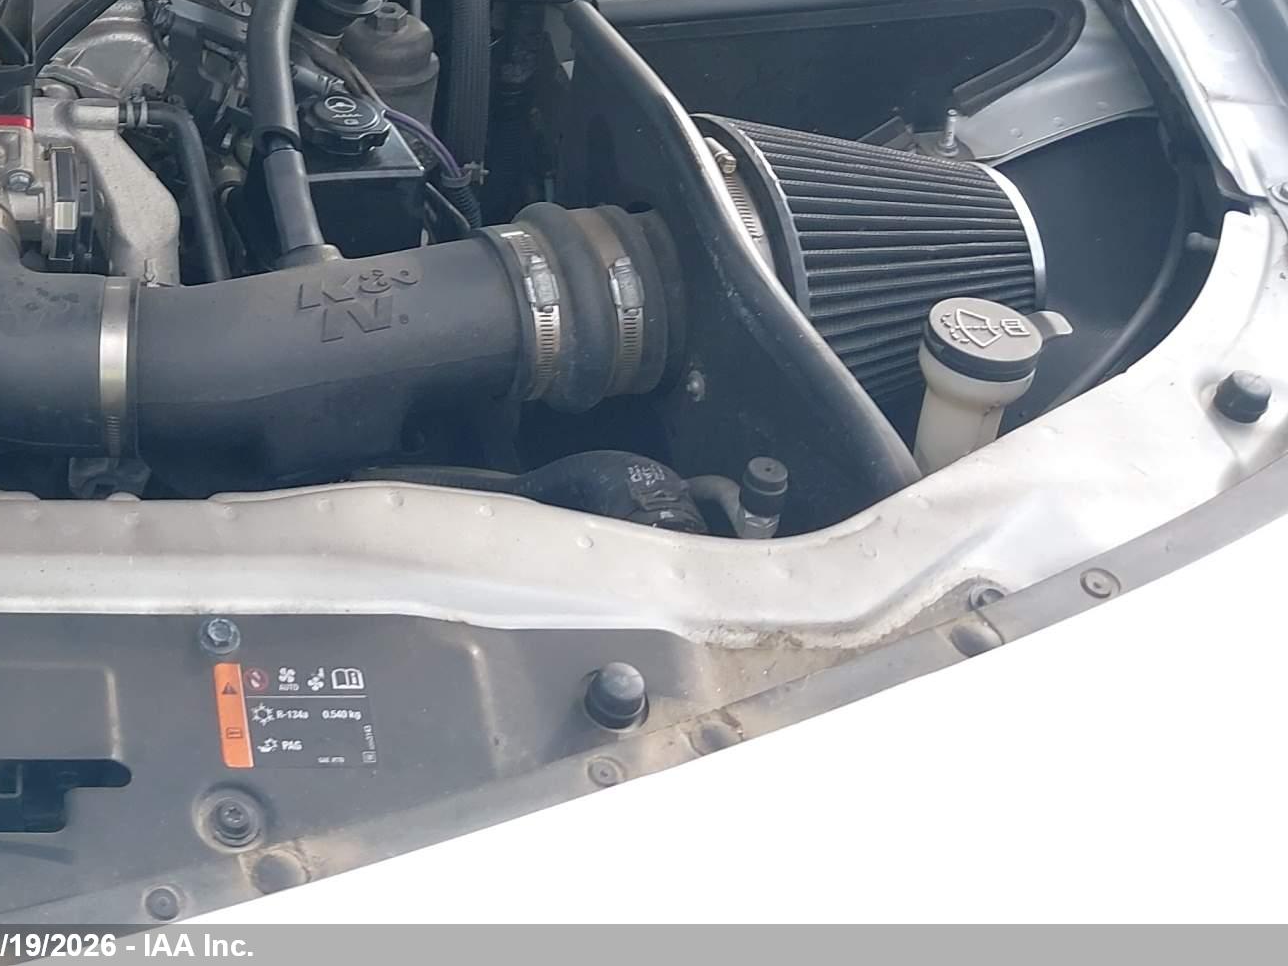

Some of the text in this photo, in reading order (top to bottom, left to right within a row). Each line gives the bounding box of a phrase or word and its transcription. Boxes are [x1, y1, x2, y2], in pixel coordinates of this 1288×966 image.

[276, 709, 309, 720] R-134a
[349, 710, 362, 721] kg
[281, 740, 303, 751] PAG
